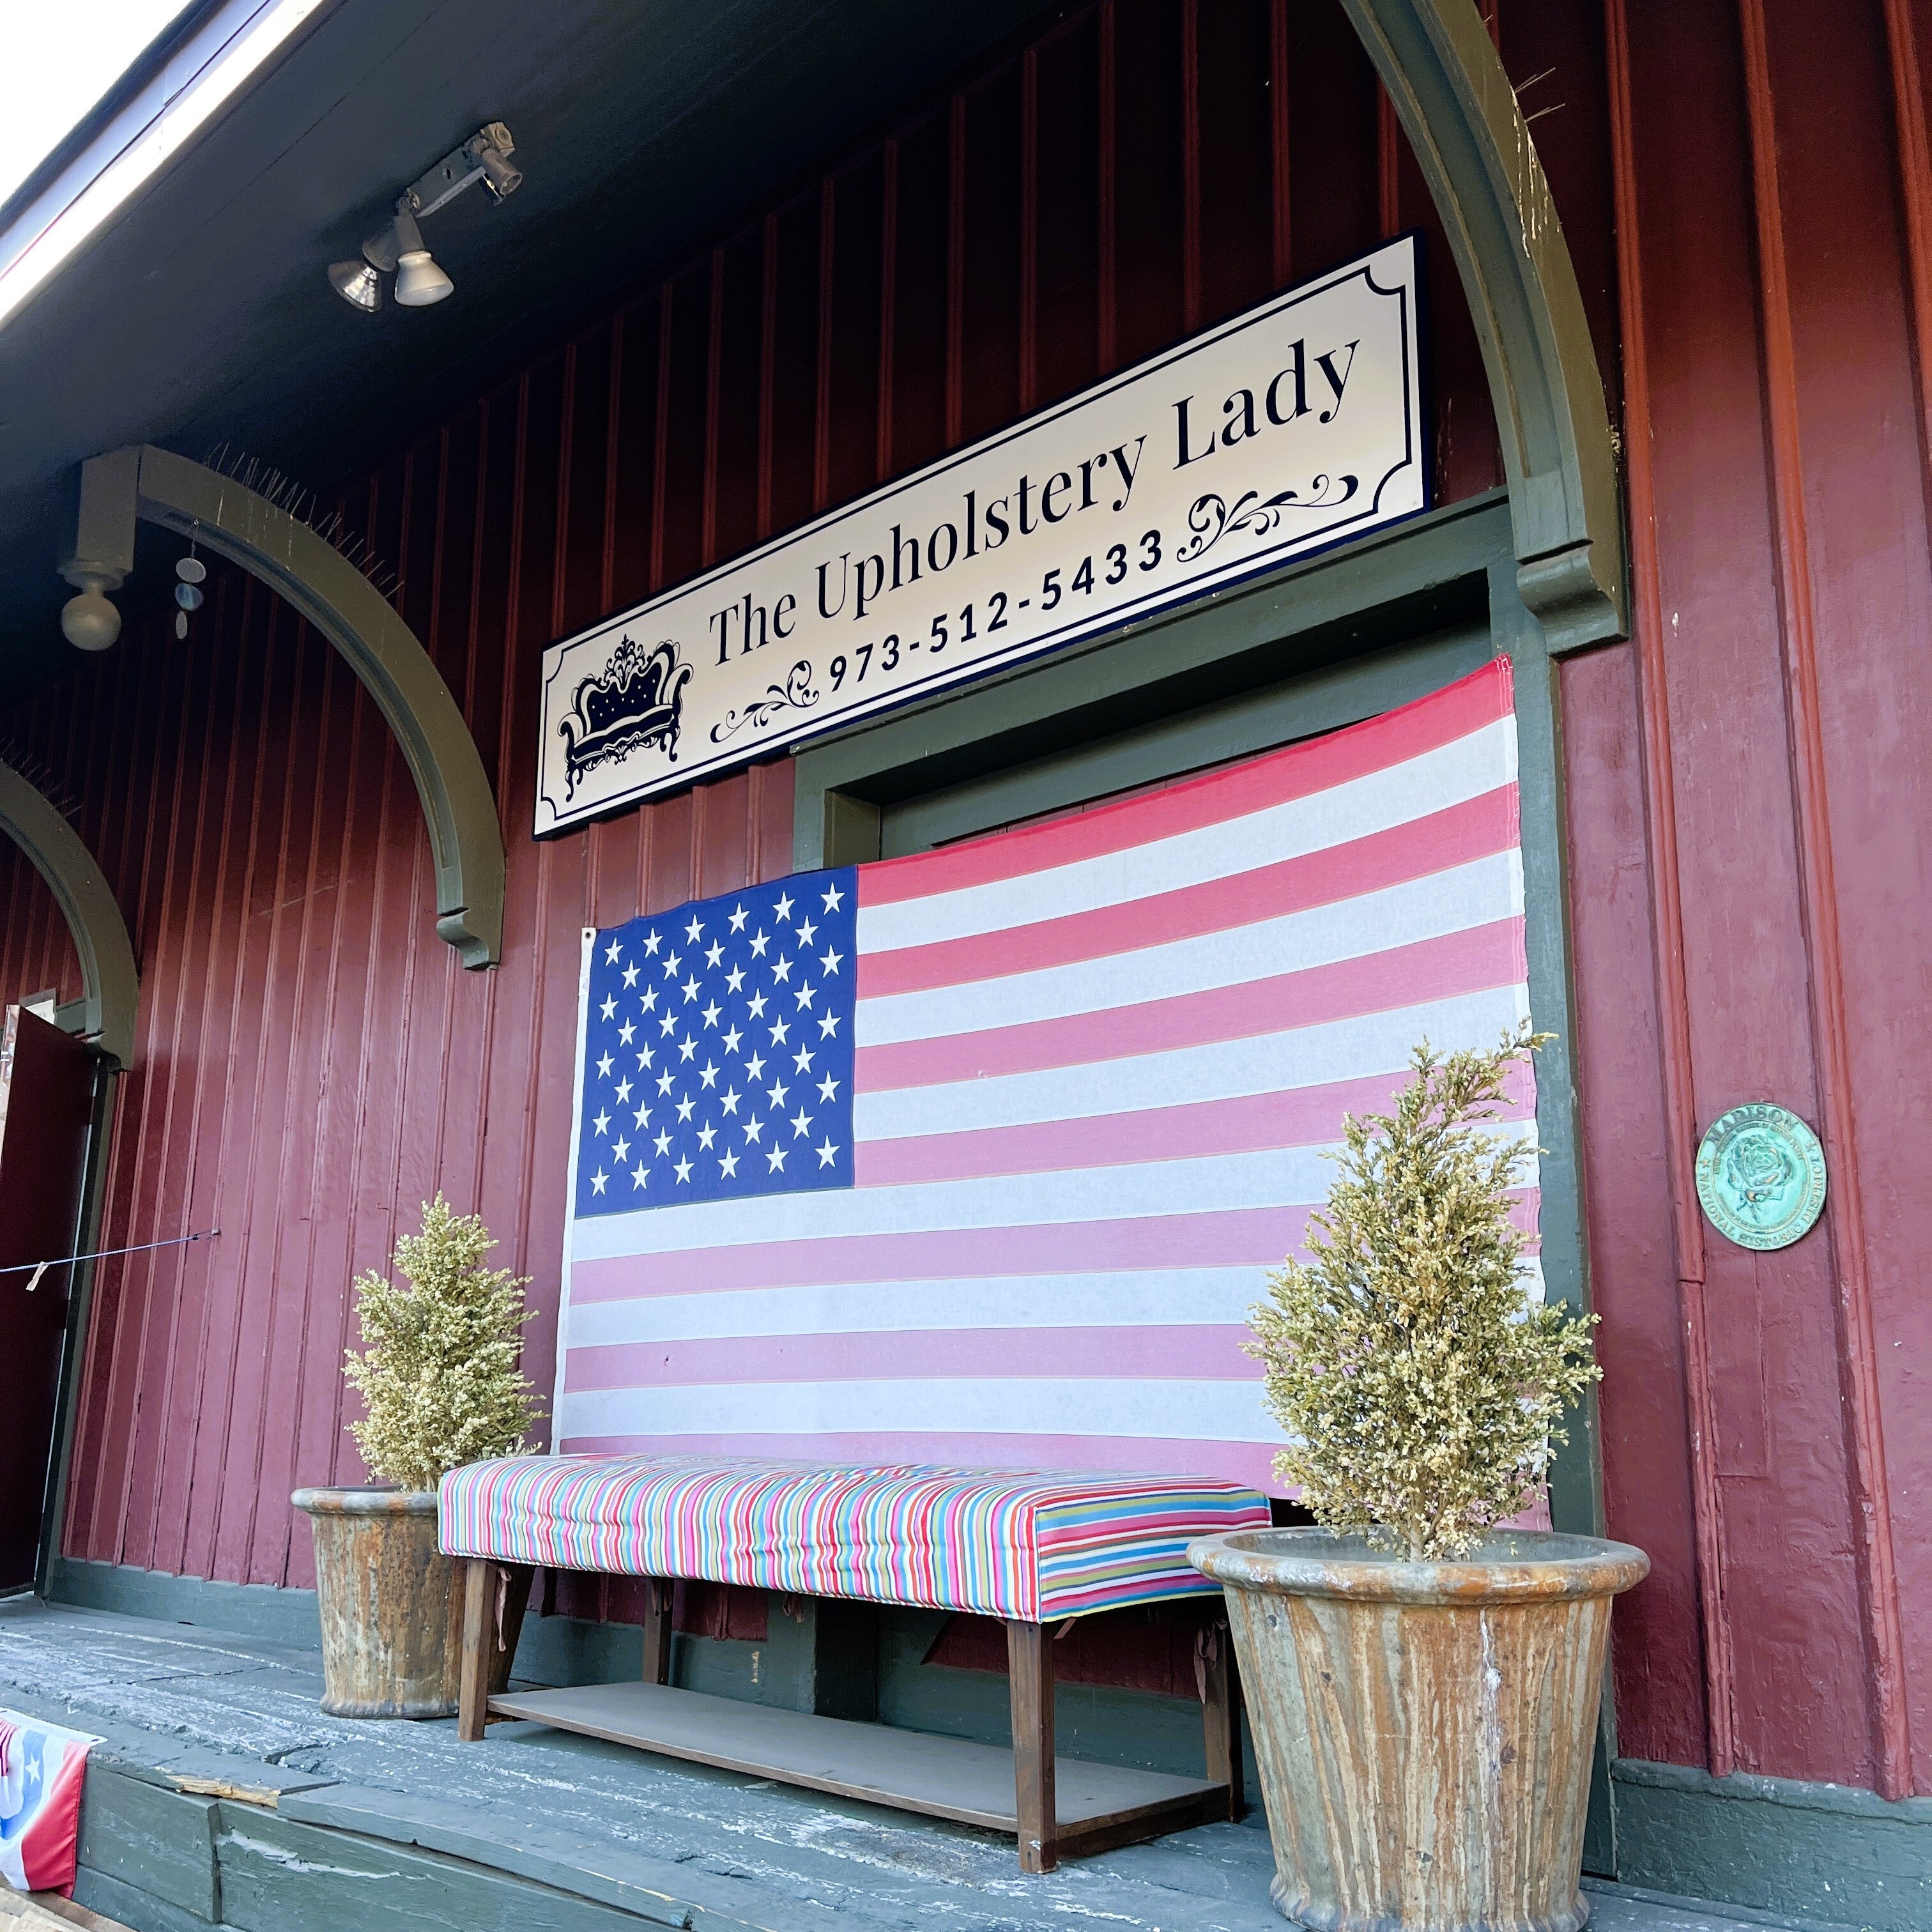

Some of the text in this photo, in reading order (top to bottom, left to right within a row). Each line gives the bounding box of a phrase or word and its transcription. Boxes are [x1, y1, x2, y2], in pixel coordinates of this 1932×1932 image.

[709, 337, 1361, 667] The Upholstery Lady
[830, 529, 1162, 693] 973-512-5433
[1707, 1106, 1798, 1147] MADISON
[1699, 1172, 1735, 1237] NATIONAL
[1738, 1222, 1803, 1247] HISTORIC
[1801, 1156, 1824, 1224] DISTRICT
